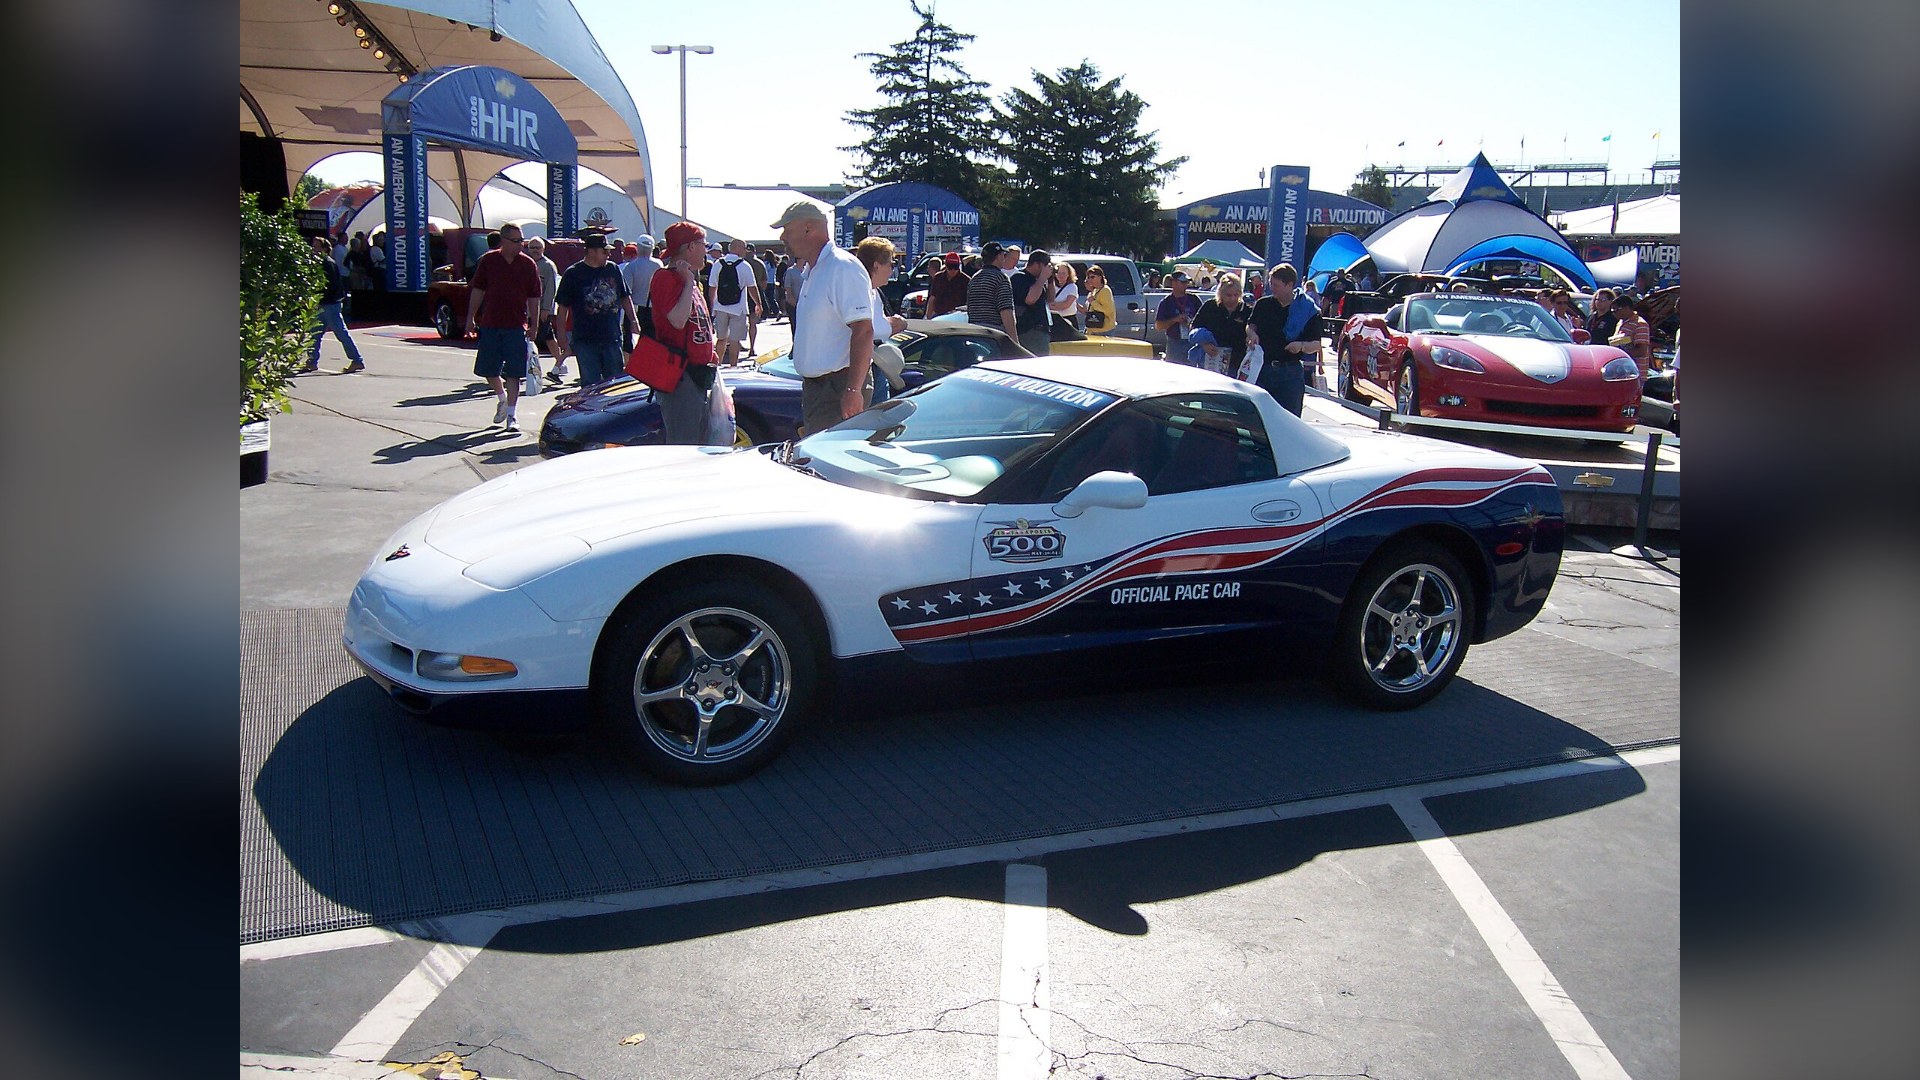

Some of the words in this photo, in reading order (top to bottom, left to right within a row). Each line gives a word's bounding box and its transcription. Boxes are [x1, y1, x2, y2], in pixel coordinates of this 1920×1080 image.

[478, 97, 540, 151] HHR
[391, 137, 404, 154] AN
[416, 139, 424, 155] AN
[391, 157, 406, 216] AMERICAN
[416, 159, 425, 218] AMERICAN
[1285, 188, 1297, 204] AN
[553, 183, 564, 228] AMERICAN
[872, 207, 886, 221] AN
[1225, 205, 1244, 220] AN
[1313, 207, 1385, 225] REVOLUTION
[1188, 221, 1203, 233] AN
[1204, 222, 1252, 234] AMERICAN
[1281, 206, 1297, 262] AMERICAN
[990, 535, 1059, 556] 500
[1110, 586, 1171, 605] OFFICIAL
[1174, 584, 1210, 601] PACE
[1213, 582, 1241, 598] CAR
